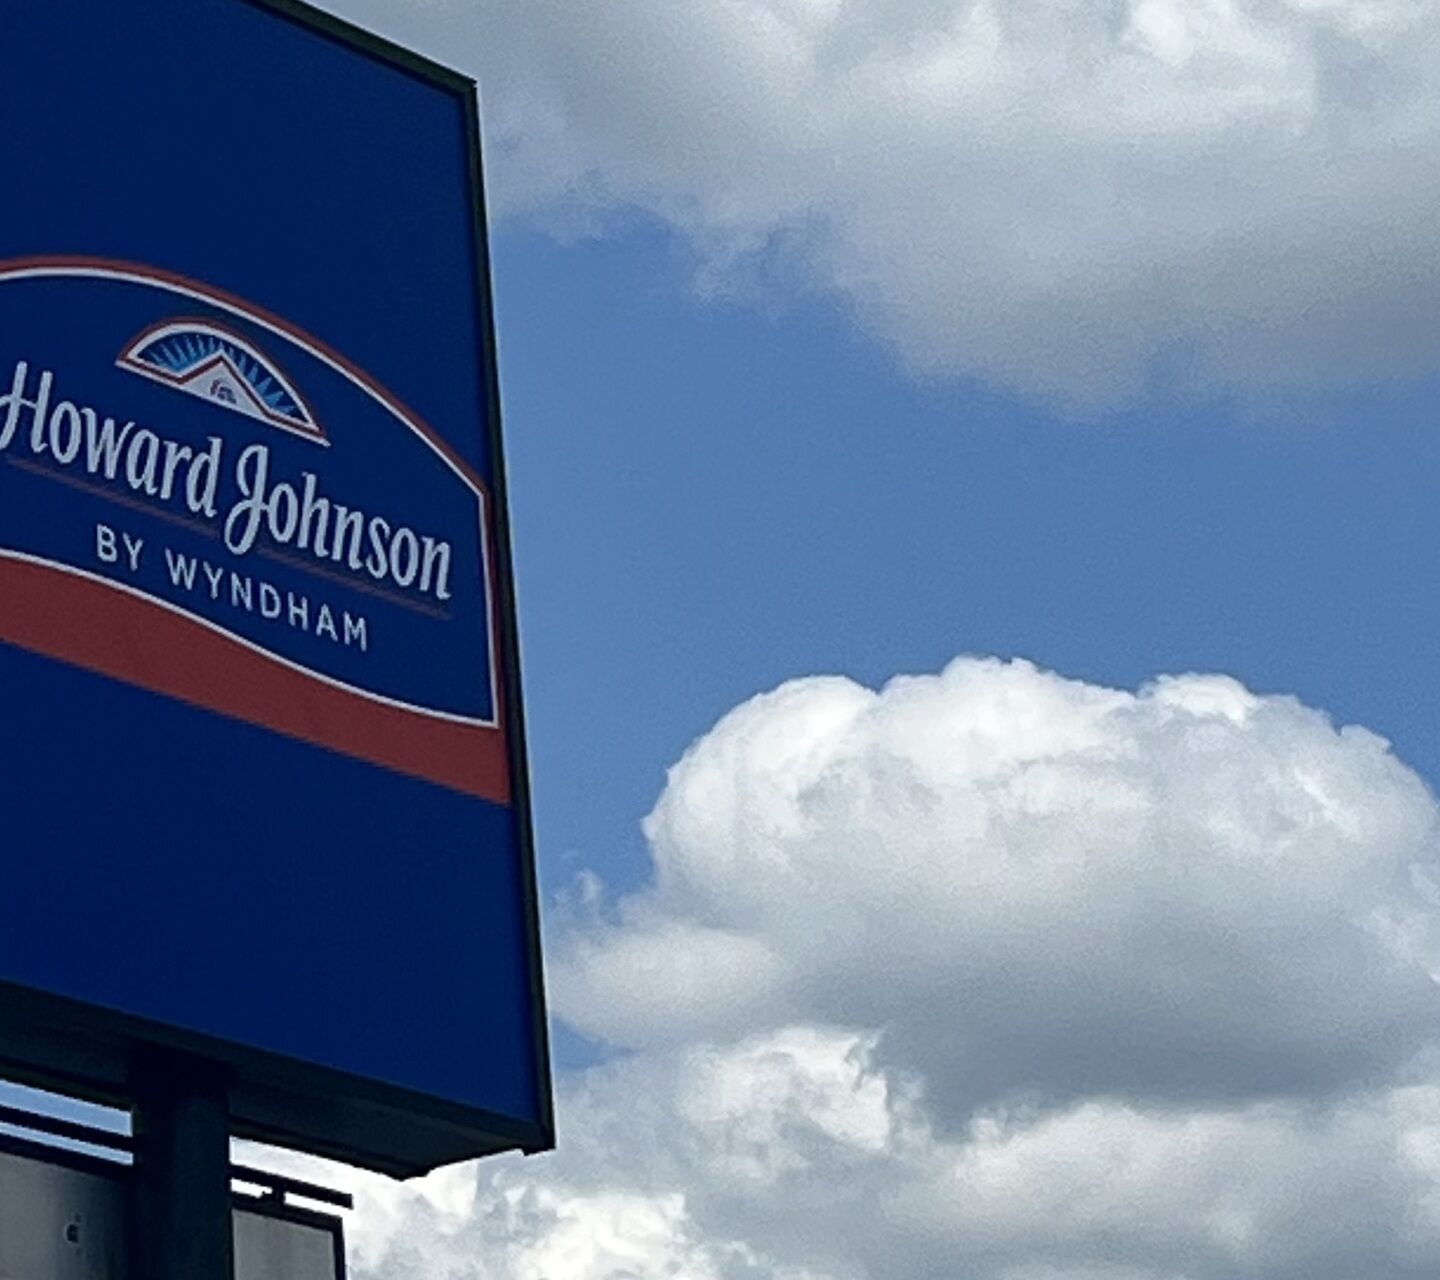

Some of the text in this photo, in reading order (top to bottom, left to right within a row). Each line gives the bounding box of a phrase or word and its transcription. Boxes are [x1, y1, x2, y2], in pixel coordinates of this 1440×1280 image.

[95, 524, 368, 651] BY WYNDHAM
[224, 444, 452, 600] Johnson
